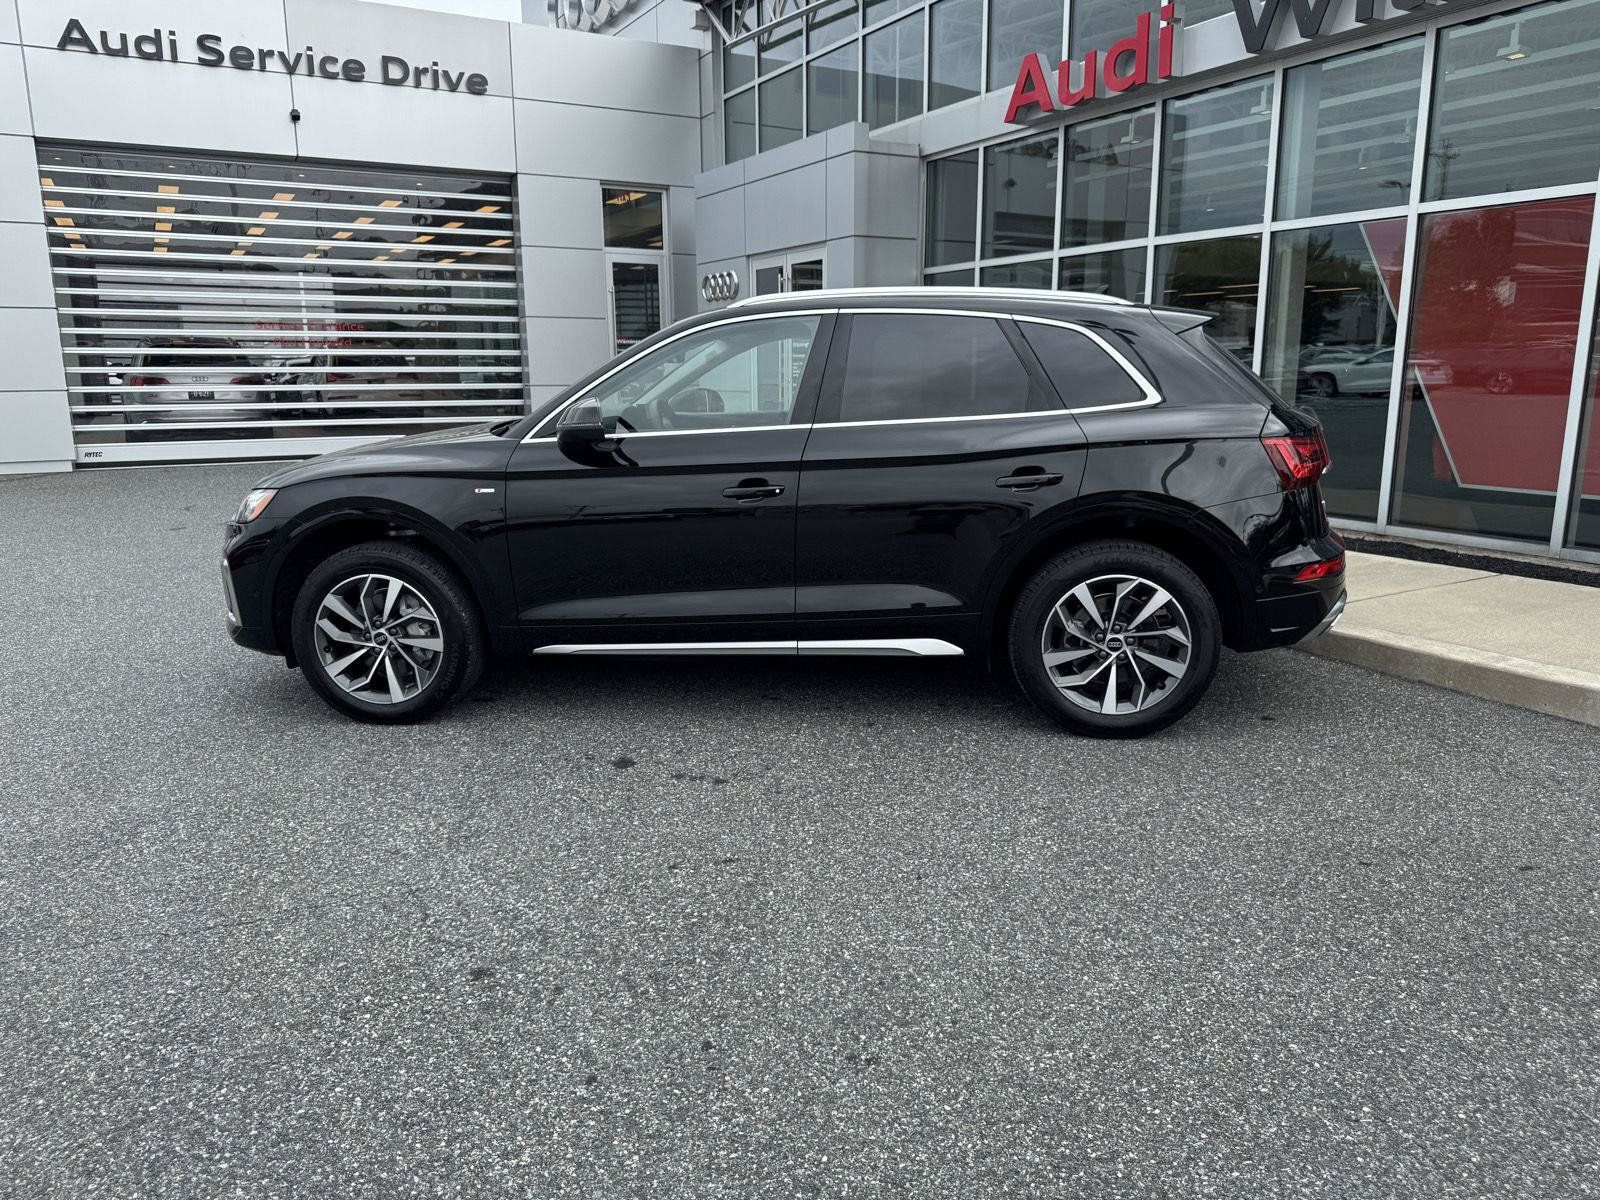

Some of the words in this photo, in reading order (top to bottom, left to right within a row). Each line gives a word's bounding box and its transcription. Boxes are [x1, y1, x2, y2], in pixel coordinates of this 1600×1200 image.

[57, 18, 178, 62] Audi
[196, 33, 366, 81] Service
[381, 55, 489, 95] Drive
[1004, 3, 1175, 123] Audi
